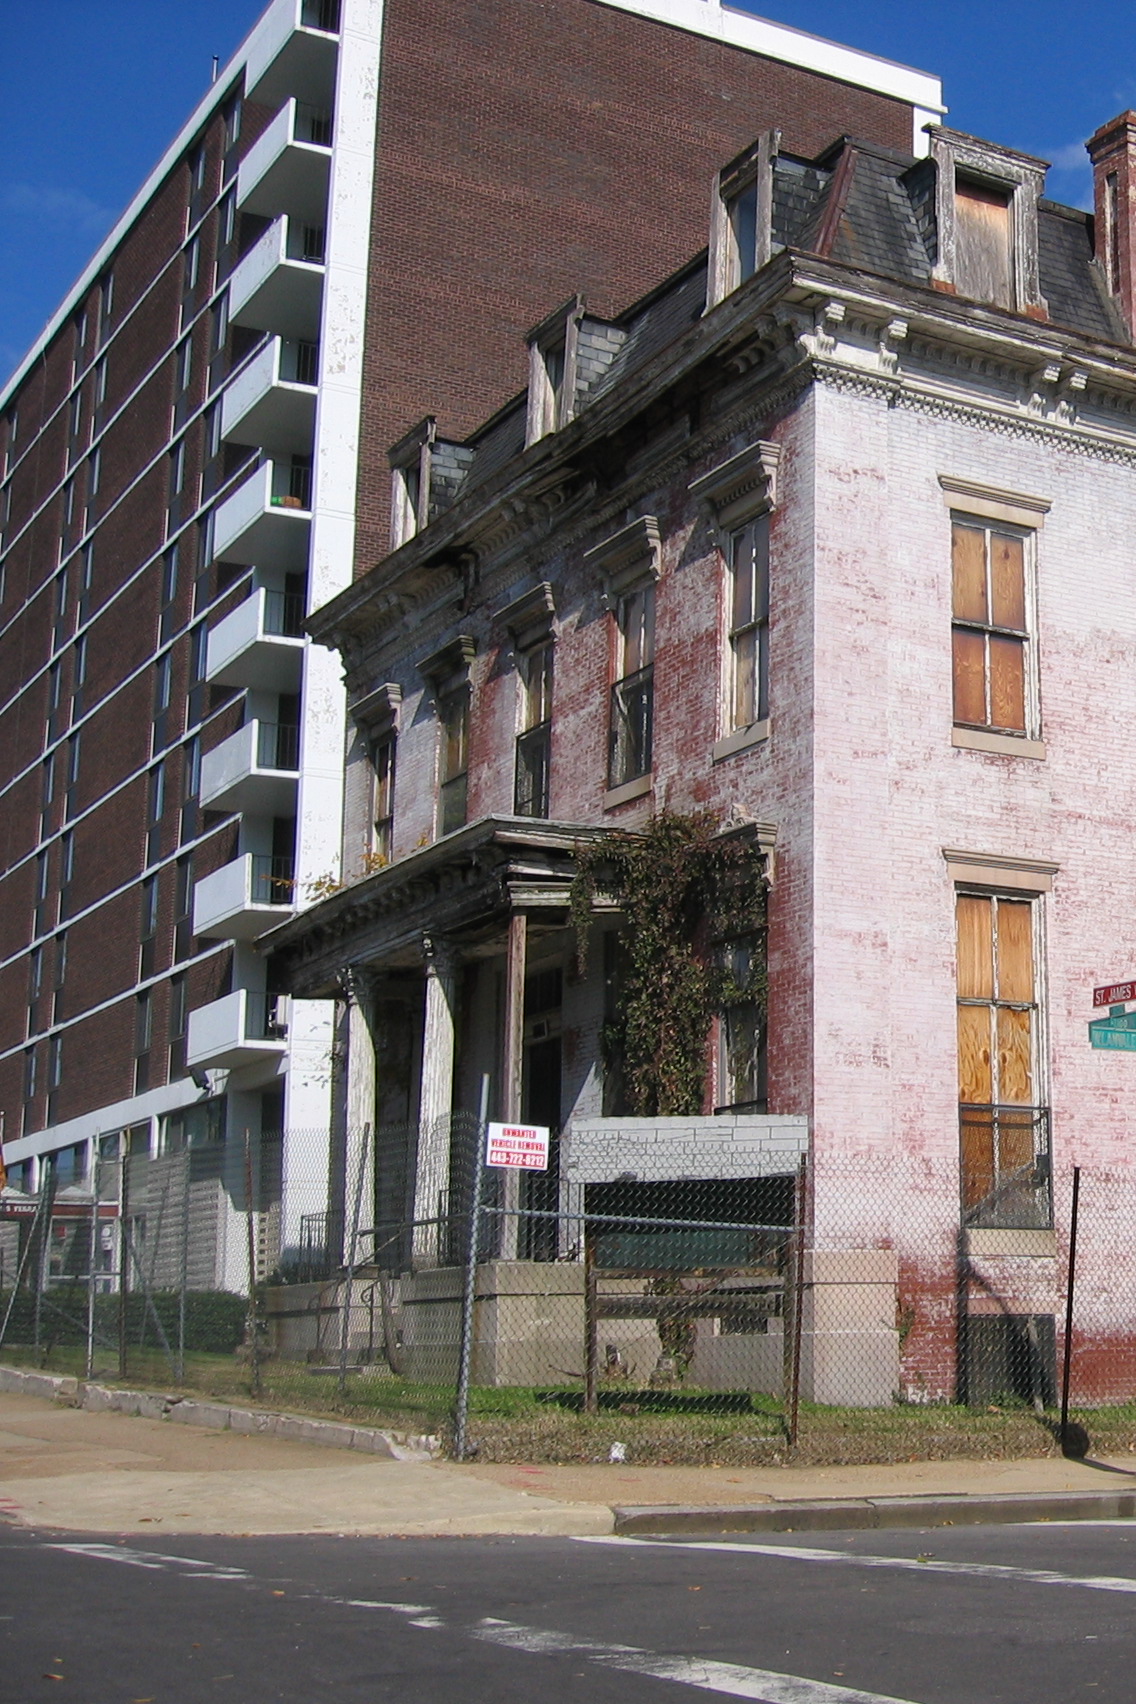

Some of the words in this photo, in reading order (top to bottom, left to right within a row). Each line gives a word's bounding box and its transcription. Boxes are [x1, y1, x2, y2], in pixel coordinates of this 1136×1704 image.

[1095, 990, 1106, 1005] ST.
[1108, 985, 1132, 1002] JAMES
[503, 1128, 536, 1139] UNWANTED
[491, 1138, 516, 1149] VEHICLE
[518, 1140, 545, 1151] REMOVAL
